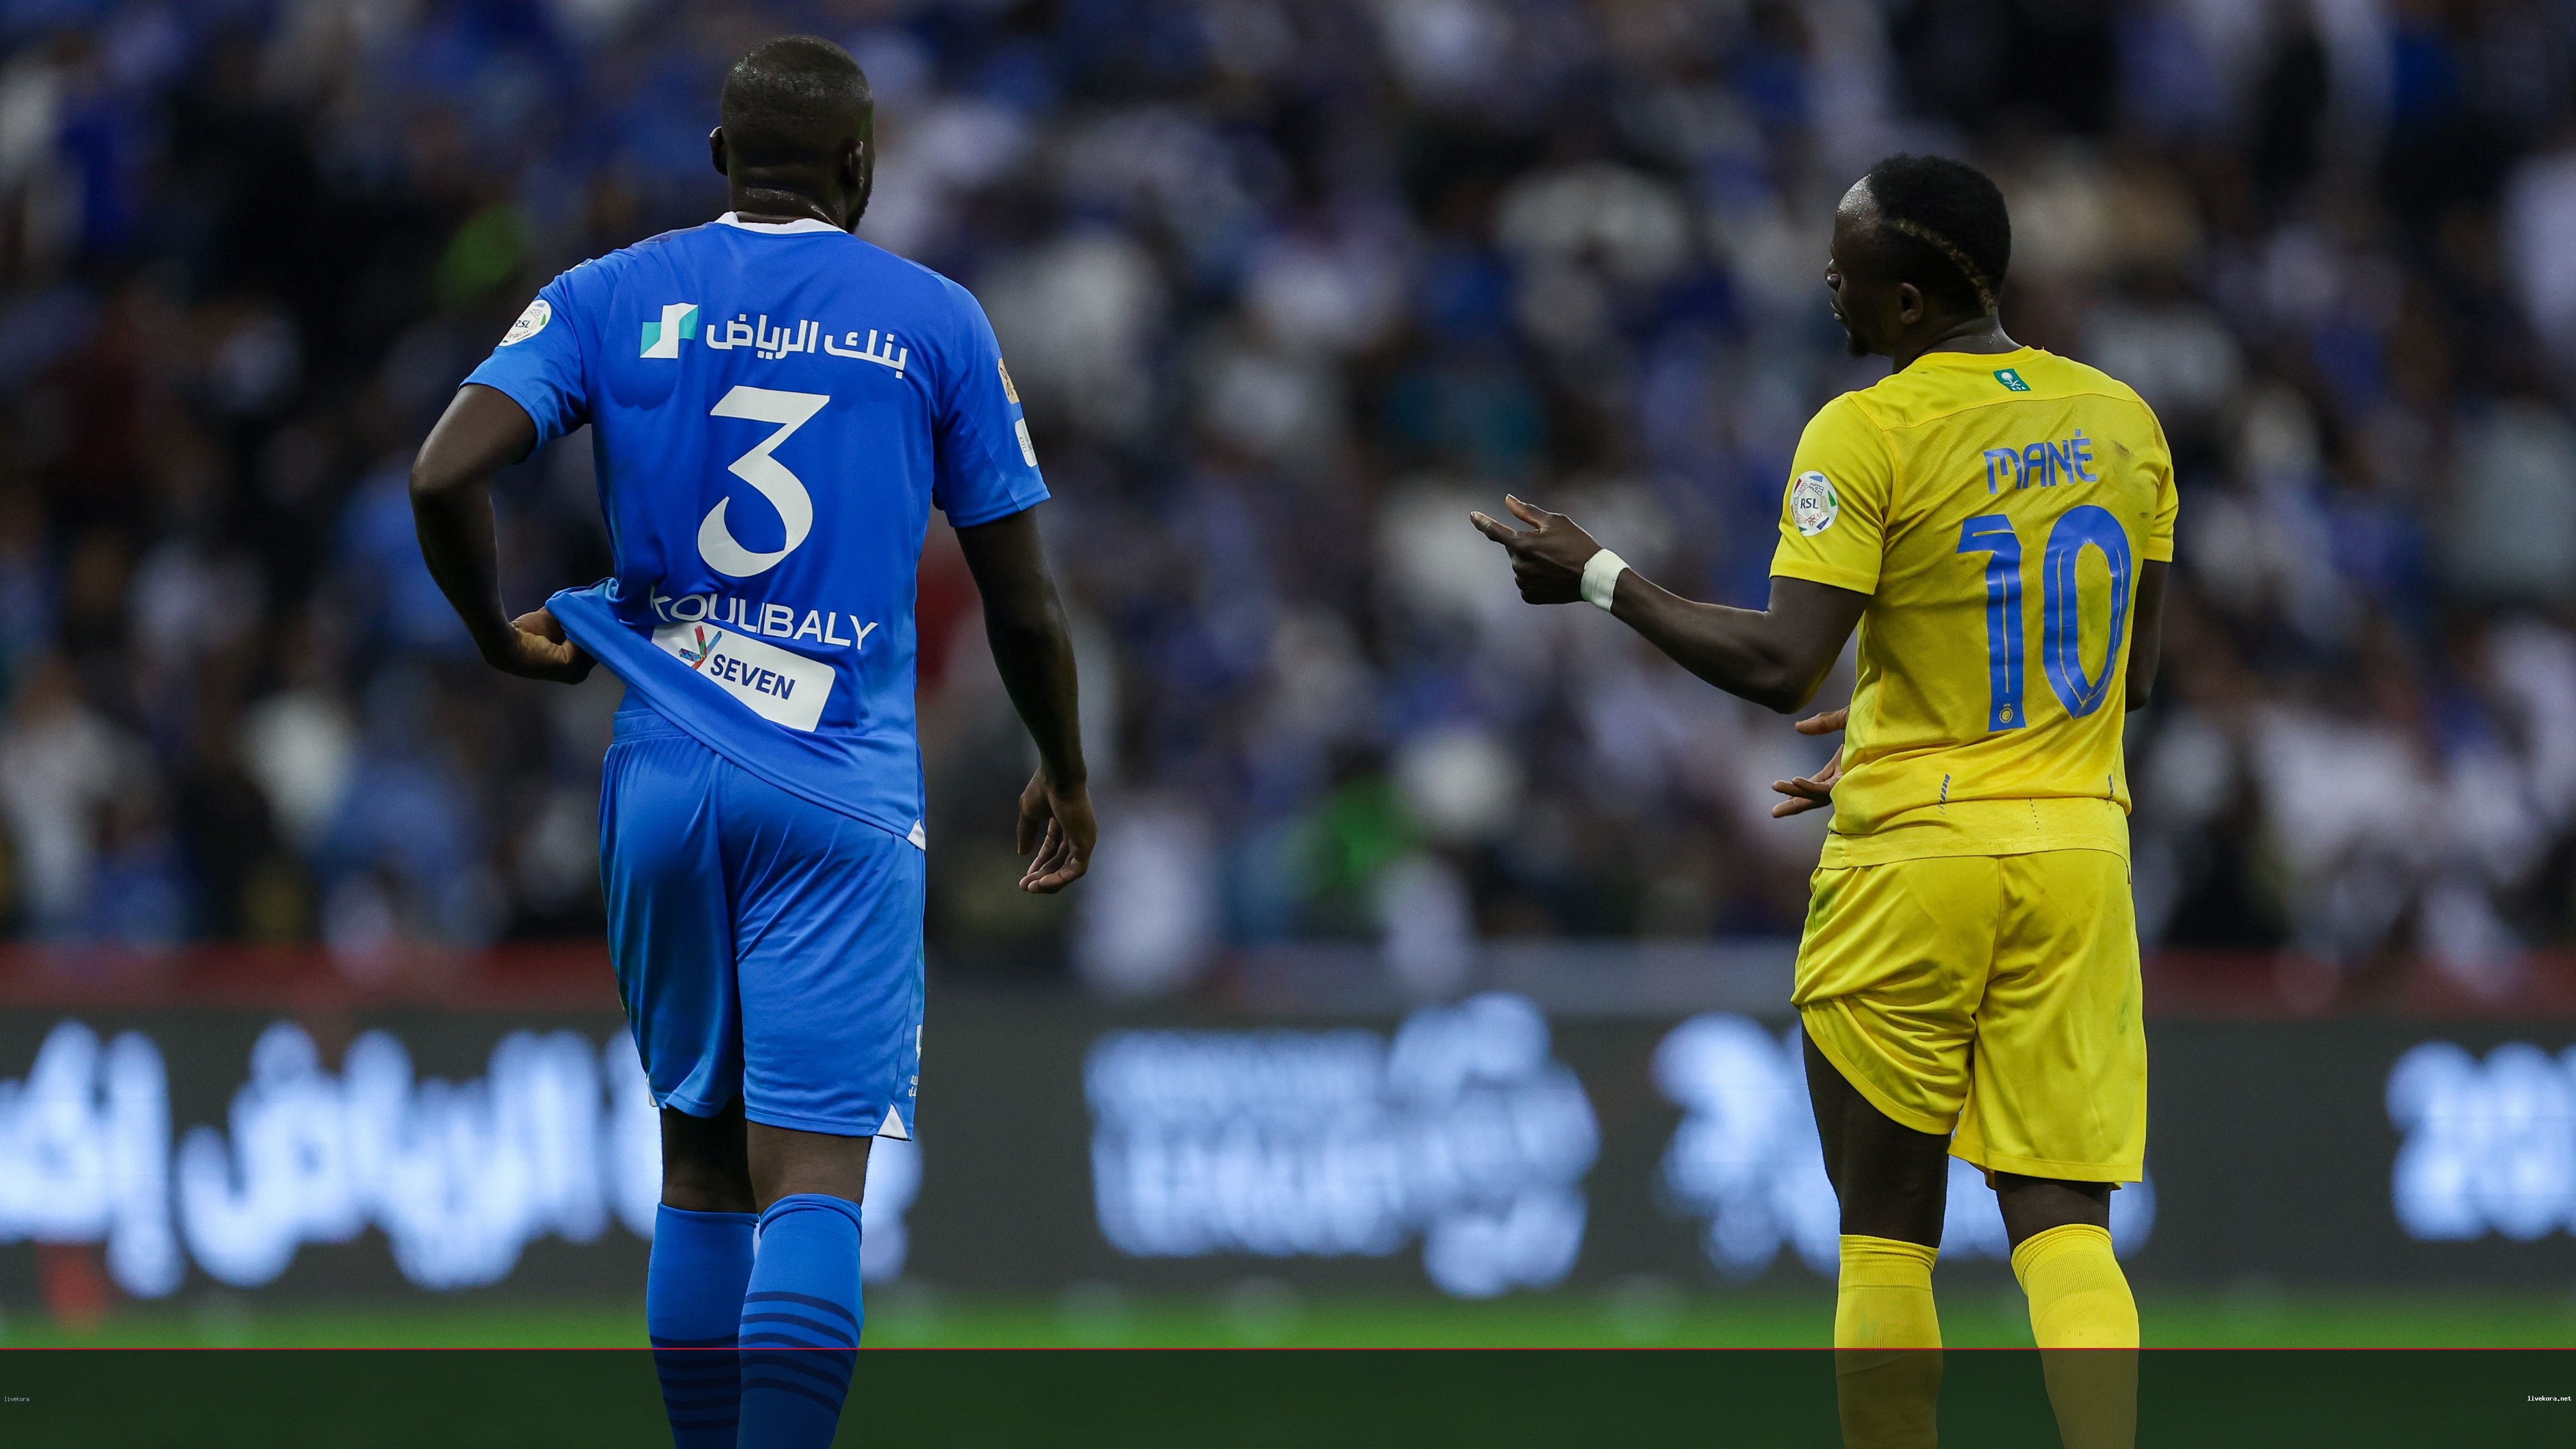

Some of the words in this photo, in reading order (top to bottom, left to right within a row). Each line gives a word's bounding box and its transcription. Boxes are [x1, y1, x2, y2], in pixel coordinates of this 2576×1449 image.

[706, 314, 819, 360] الرياض
[824, 329, 908, 379] بنك
[698, 385, 830, 577] 3
[1983, 429, 2098, 495] MANÉ
[1800, 498, 1819, 509] RSL
[649, 585, 879, 650] KOULIBALY
[1957, 505, 2132, 732] 10
[710, 653, 796, 700] SEVEN
